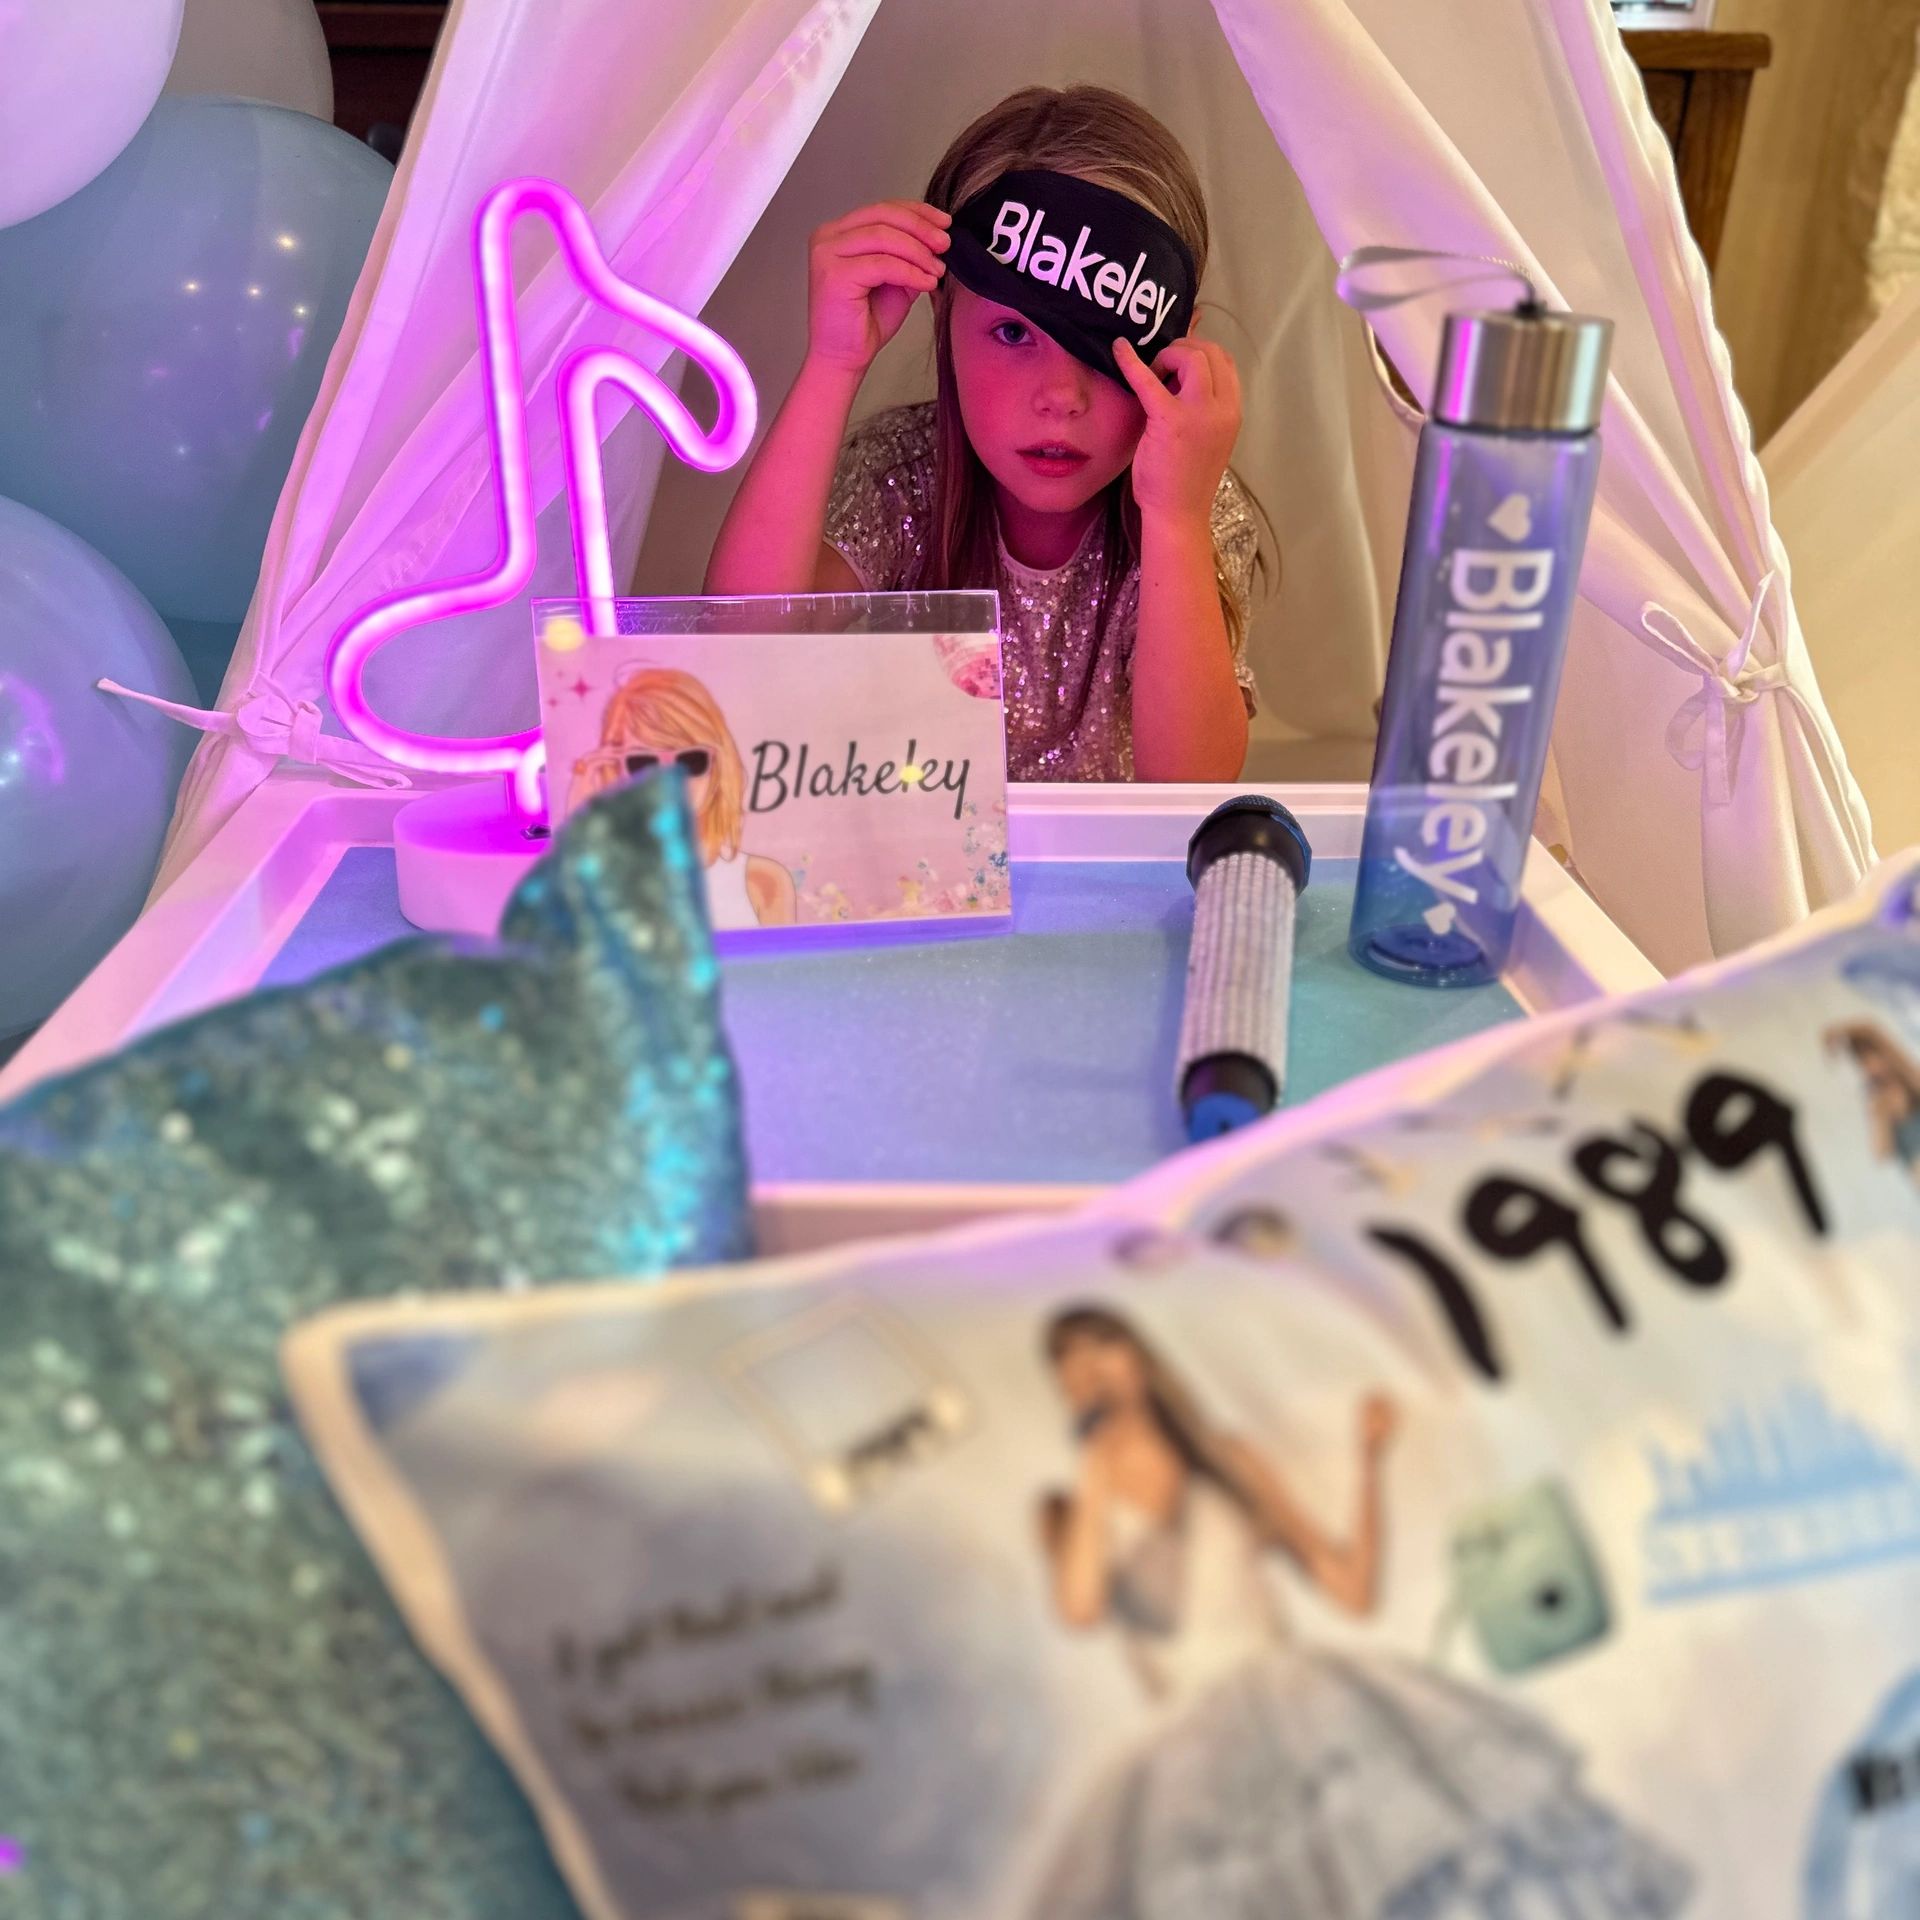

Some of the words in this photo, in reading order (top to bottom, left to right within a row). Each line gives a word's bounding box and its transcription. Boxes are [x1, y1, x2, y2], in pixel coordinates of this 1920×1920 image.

[986, 201, 1178, 346] Blakeley
[748, 738, 971, 820] Blakeley
[1394, 548, 1555, 904] Blakeley
[1364, 1070, 1832, 1385] 1989
